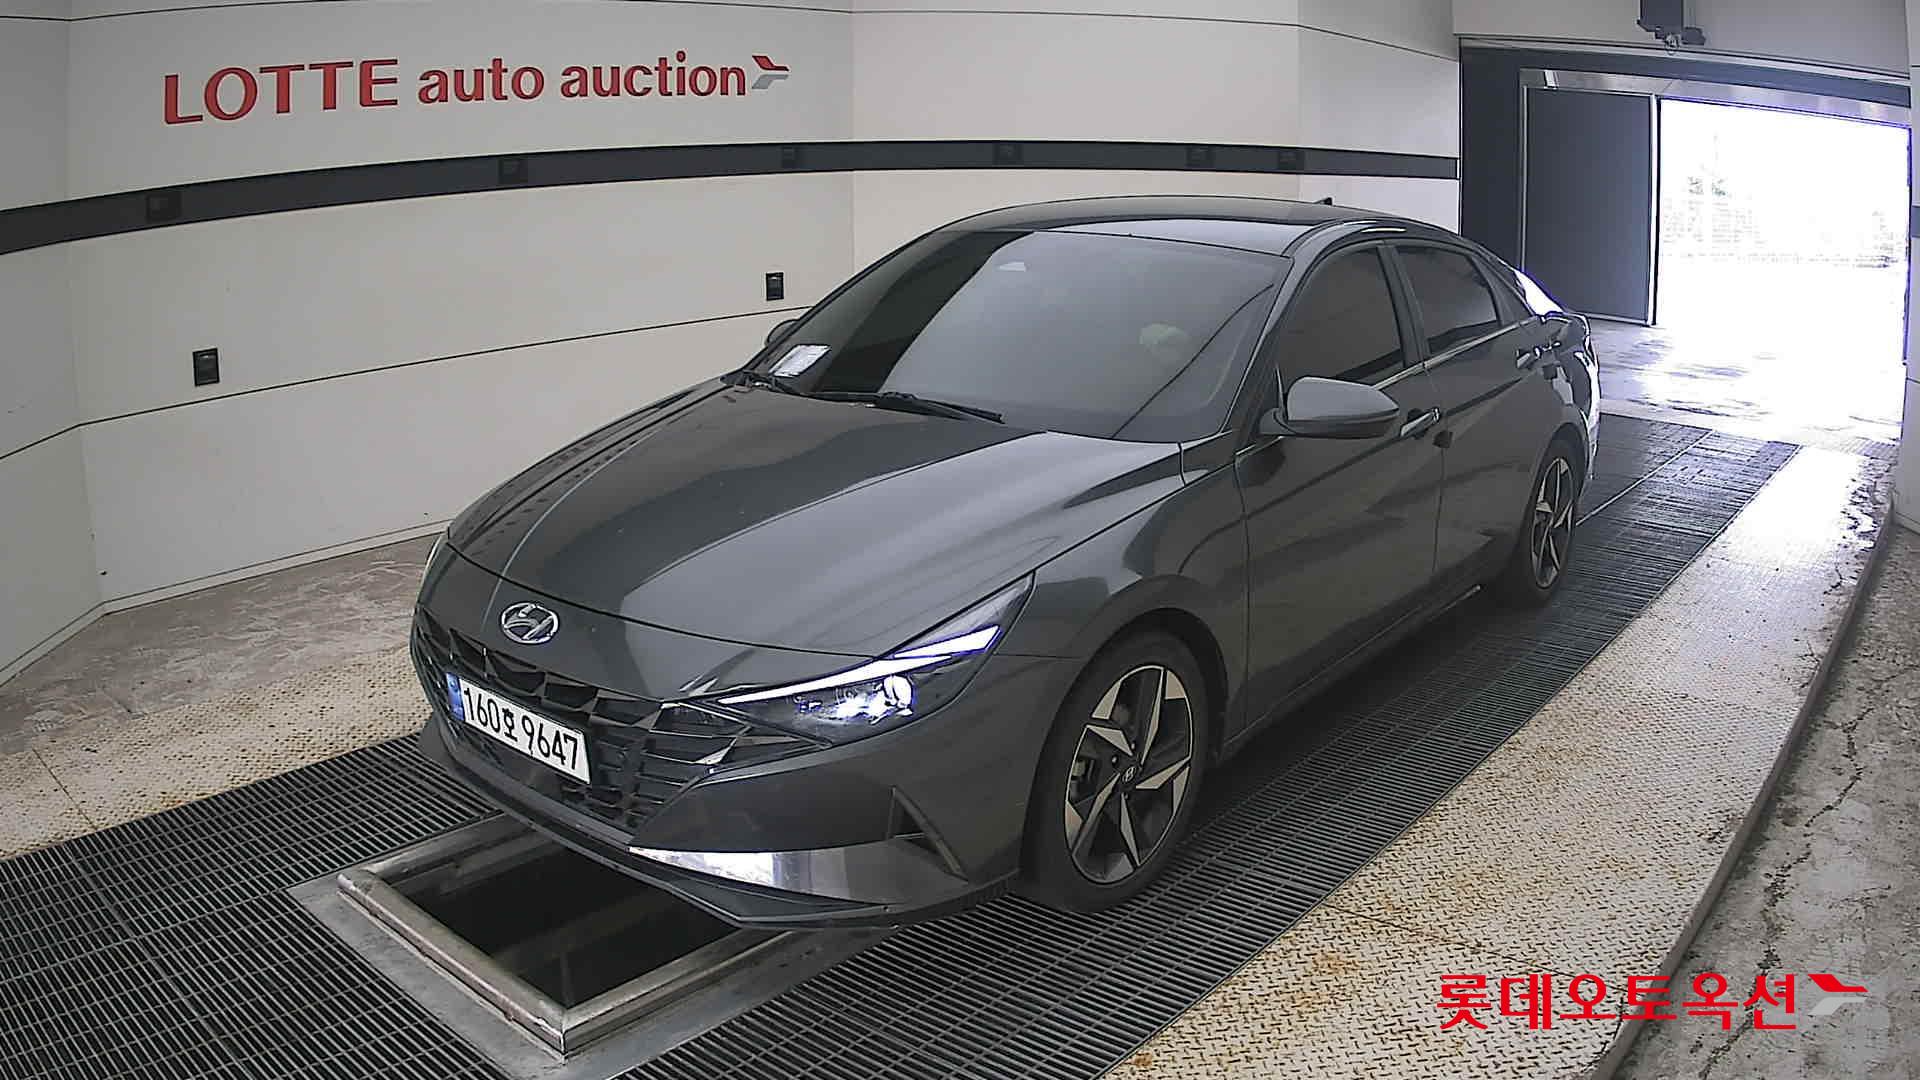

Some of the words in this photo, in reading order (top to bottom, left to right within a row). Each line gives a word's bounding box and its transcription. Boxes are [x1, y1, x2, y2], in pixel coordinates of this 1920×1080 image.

[164, 58, 399, 125] LOTTE
[417, 57, 545, 104] auto
[560, 50, 747, 98] auction
[522, 715, 578, 770] 9647
